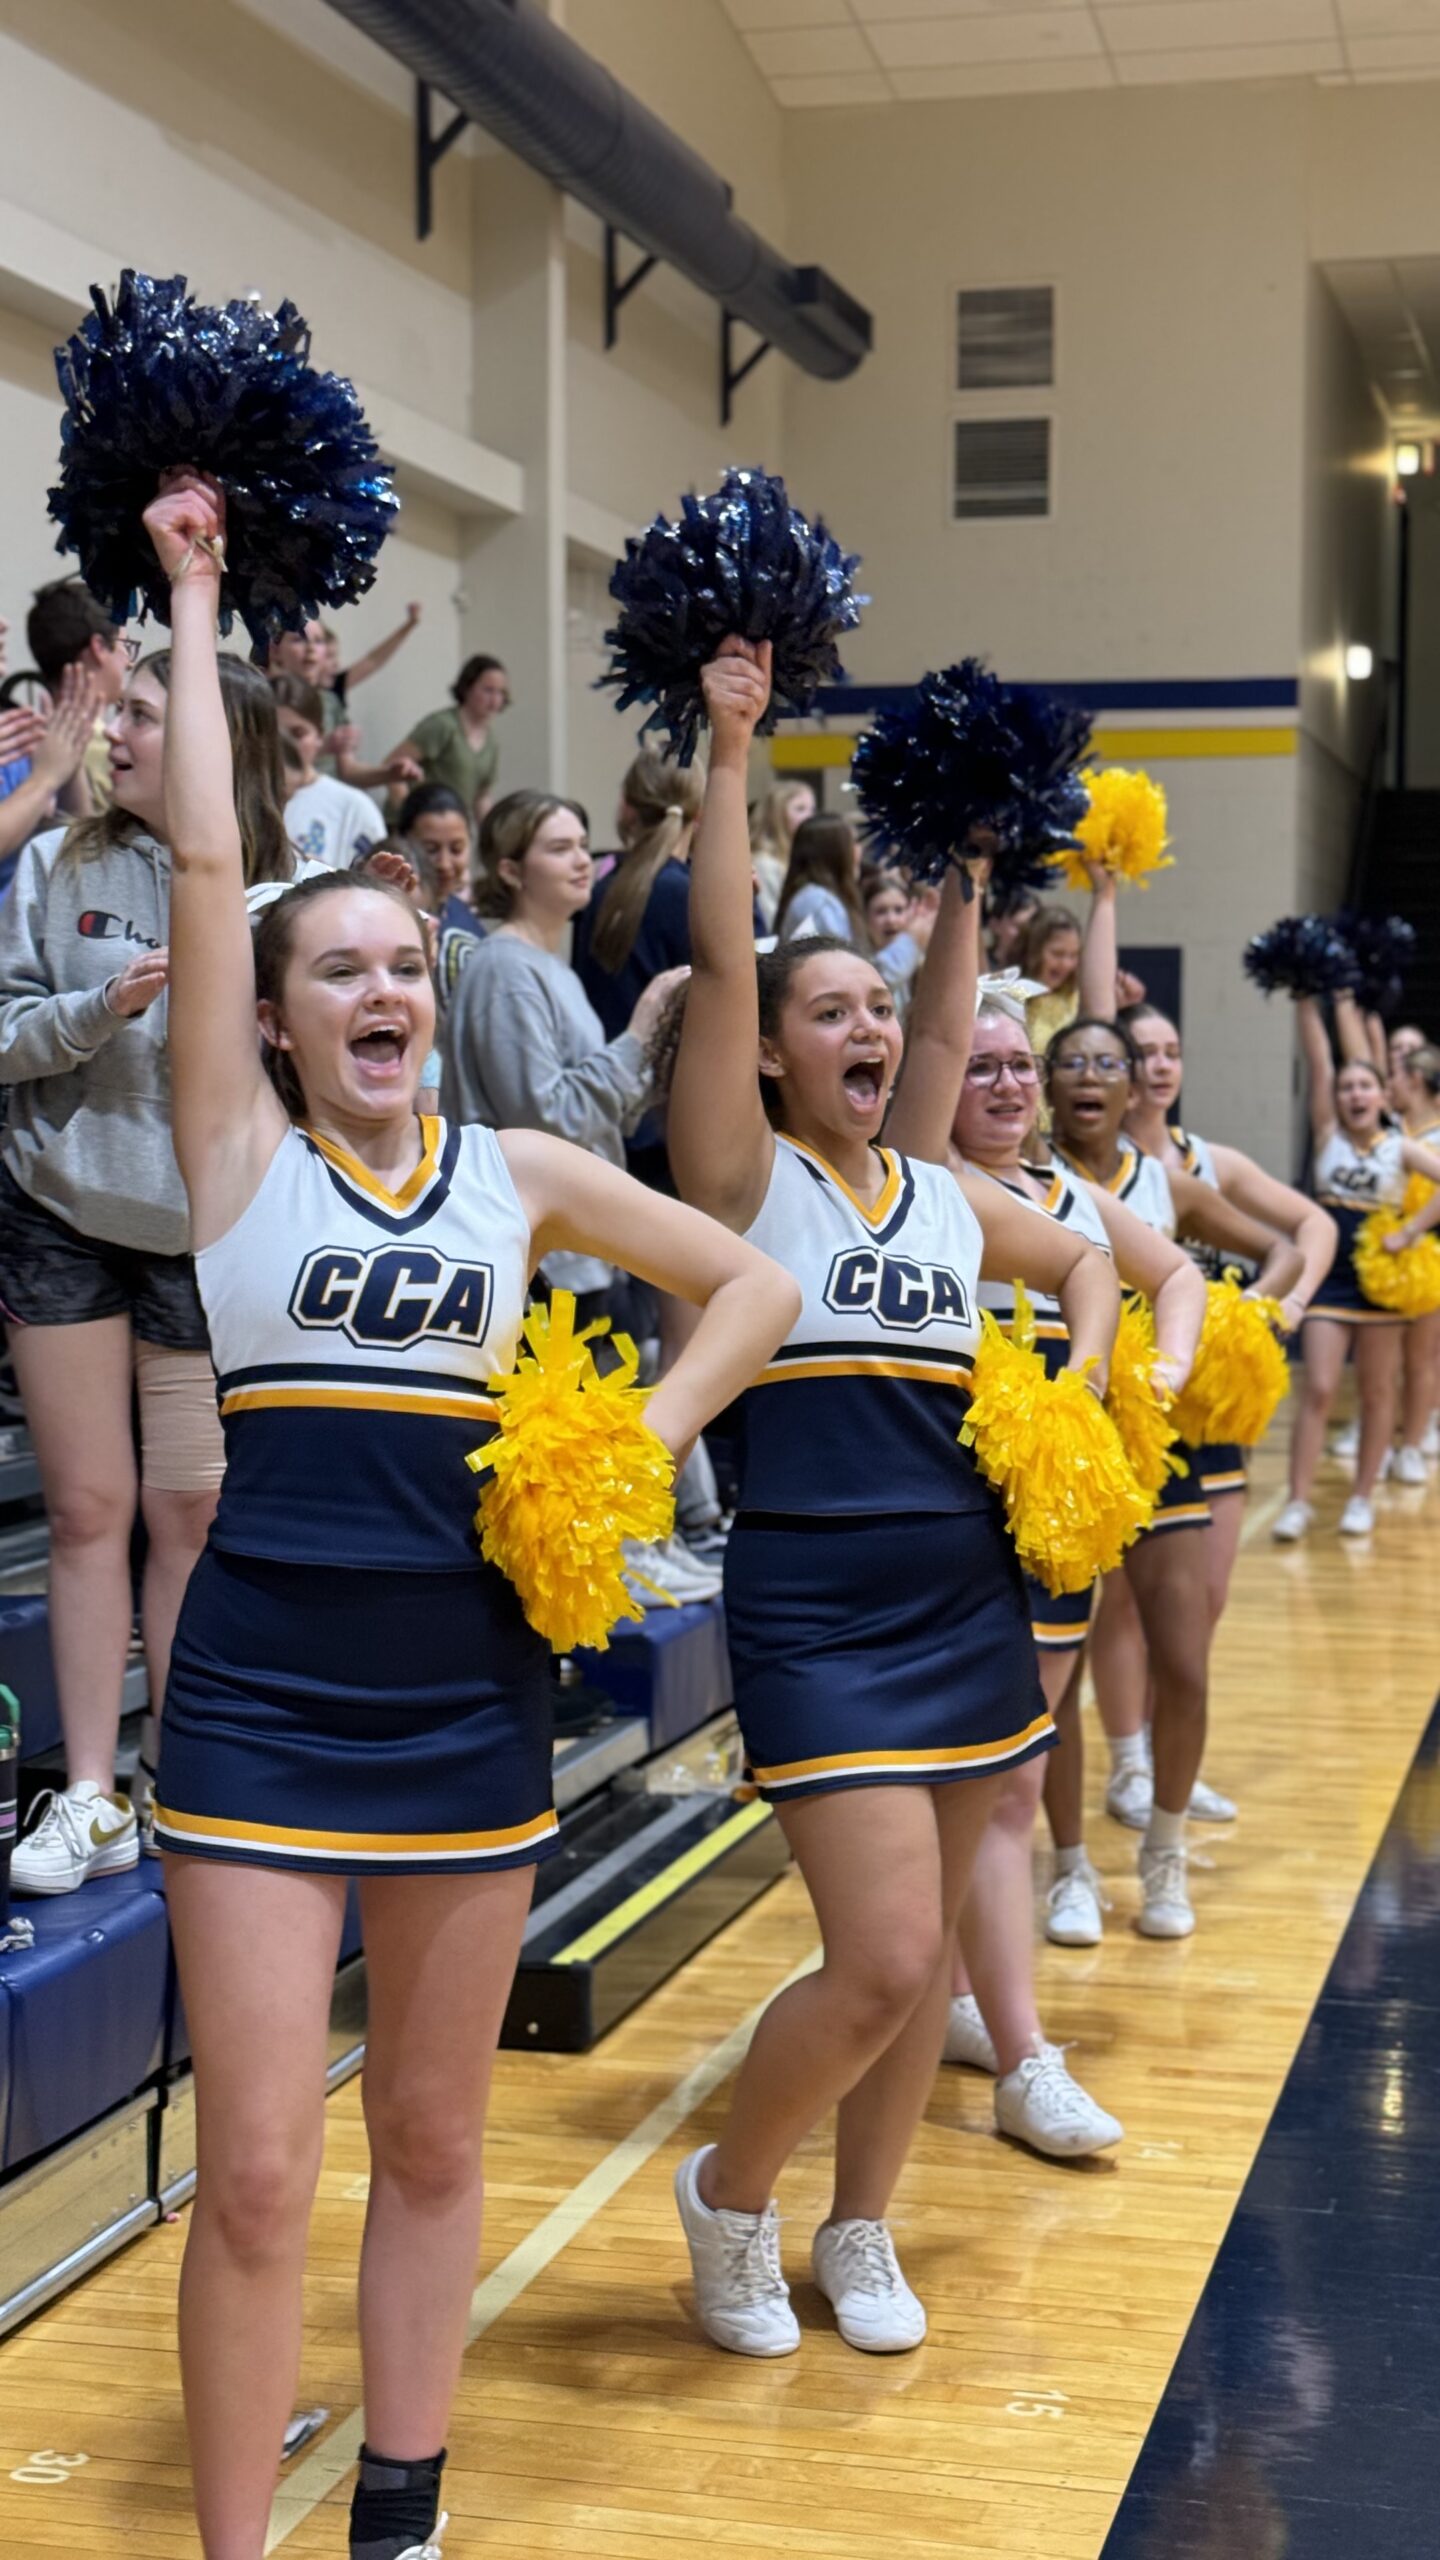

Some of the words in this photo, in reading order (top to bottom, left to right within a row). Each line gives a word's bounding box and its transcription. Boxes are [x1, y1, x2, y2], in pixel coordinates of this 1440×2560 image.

[292, 1246, 491, 1348] CCA
[826, 1249, 970, 1329] CCA
[1006, 2389, 1071, 2419] 15
[9, 2449, 89, 2484] 30
